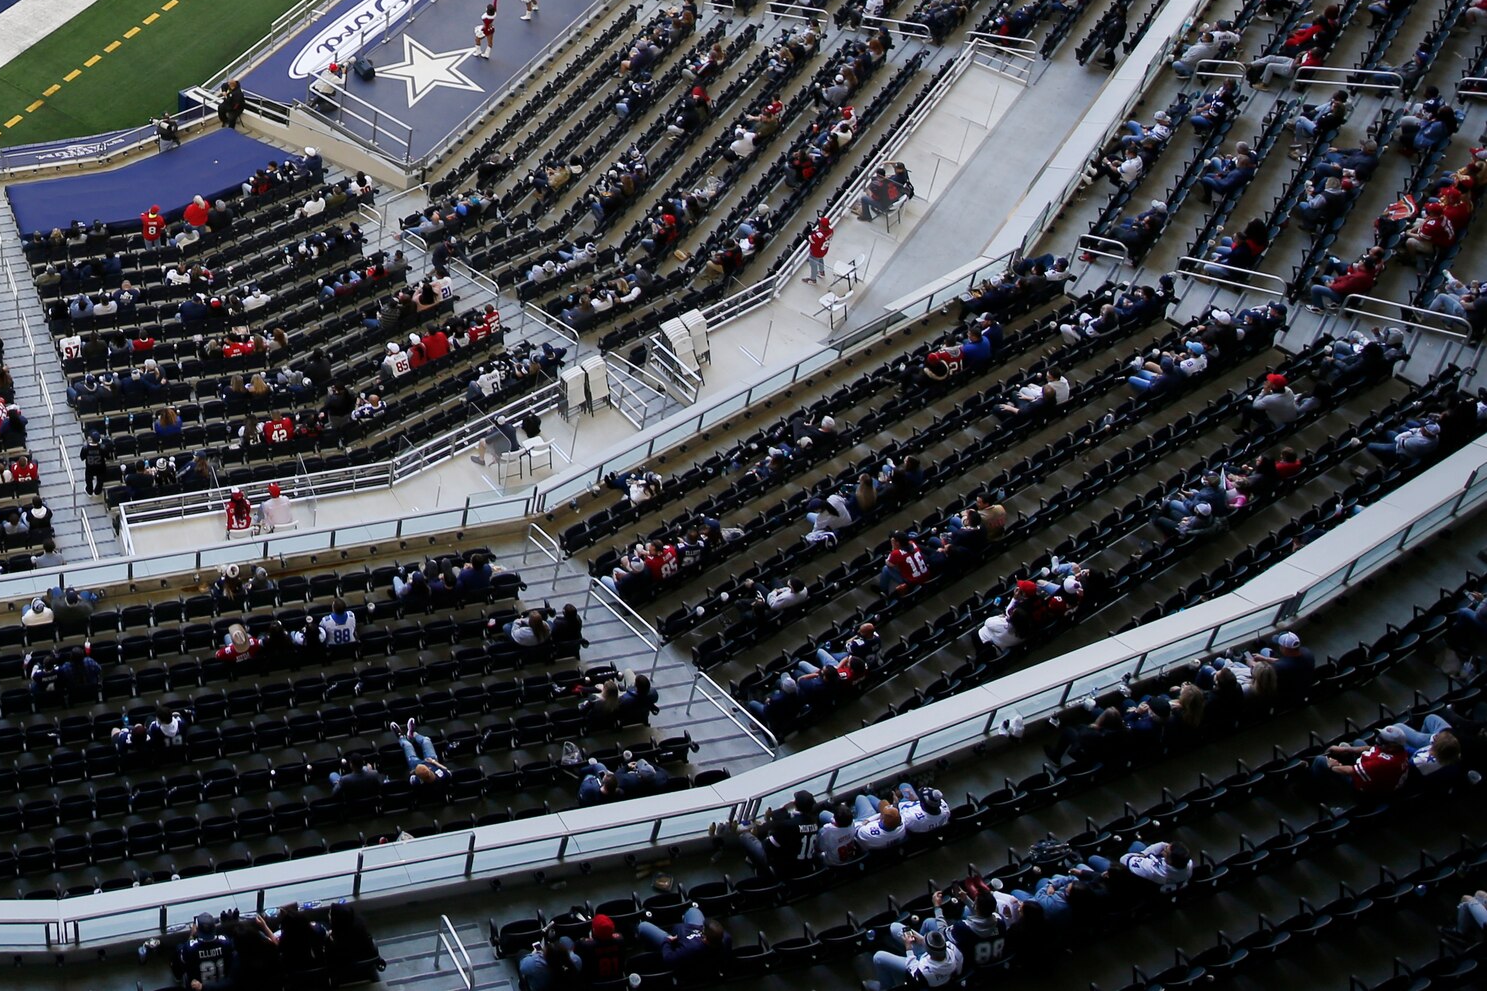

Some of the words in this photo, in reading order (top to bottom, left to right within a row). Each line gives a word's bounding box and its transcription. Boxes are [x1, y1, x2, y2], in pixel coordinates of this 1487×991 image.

[148, 226, 157, 235] 8
[442, 287, 452, 299] 21
[489, 320, 500, 333] 25
[65, 345, 80, 359] 97
[395, 361, 409, 373] 85
[271, 429, 287, 442] 42
[88, 455, 102, 466] 82
[661, 559, 679, 580] 85
[905, 556, 928, 578] 16
[334, 628, 351, 644] 88
[198, 947, 223, 959] ELLIOTT
[975, 940, 1005, 965] 88
[199, 959, 225, 982] 21
